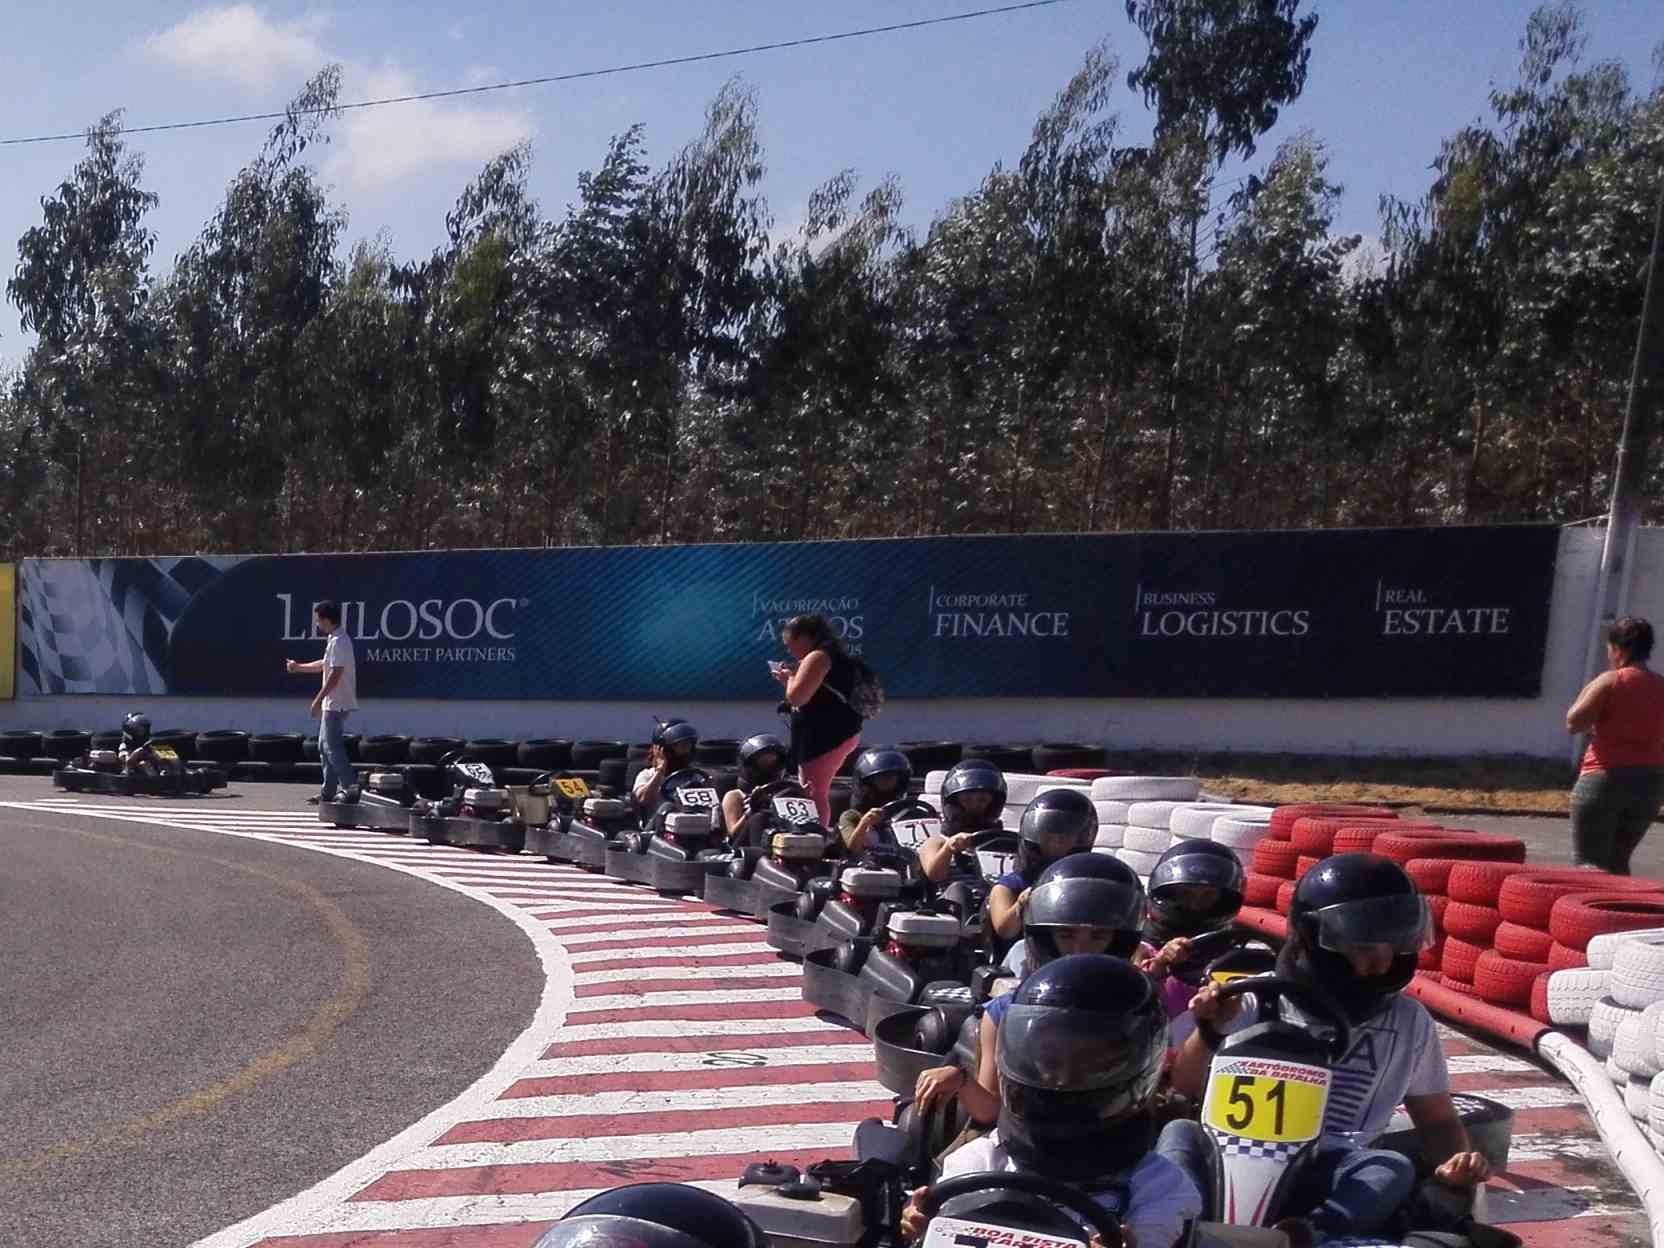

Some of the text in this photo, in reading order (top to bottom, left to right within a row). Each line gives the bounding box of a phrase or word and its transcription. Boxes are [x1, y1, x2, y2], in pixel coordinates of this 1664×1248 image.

[936, 592, 1028, 608] CORPORATE
[1143, 591, 1216, 605] BUSINESS
[1384, 589, 1427, 603] REAL
[935, 612, 1071, 638] FINANCE
[1141, 610, 1310, 637] LOGISTICS
[1383, 608, 1511, 635] ESTATE
[367, 647, 516, 662] MARKET PARTNERS
[561, 780, 585, 794] 54
[785, 801, 809, 817] 63
[1225, 1075, 1286, 1136] 51
[971, 1227, 1015, 1239] BOA
